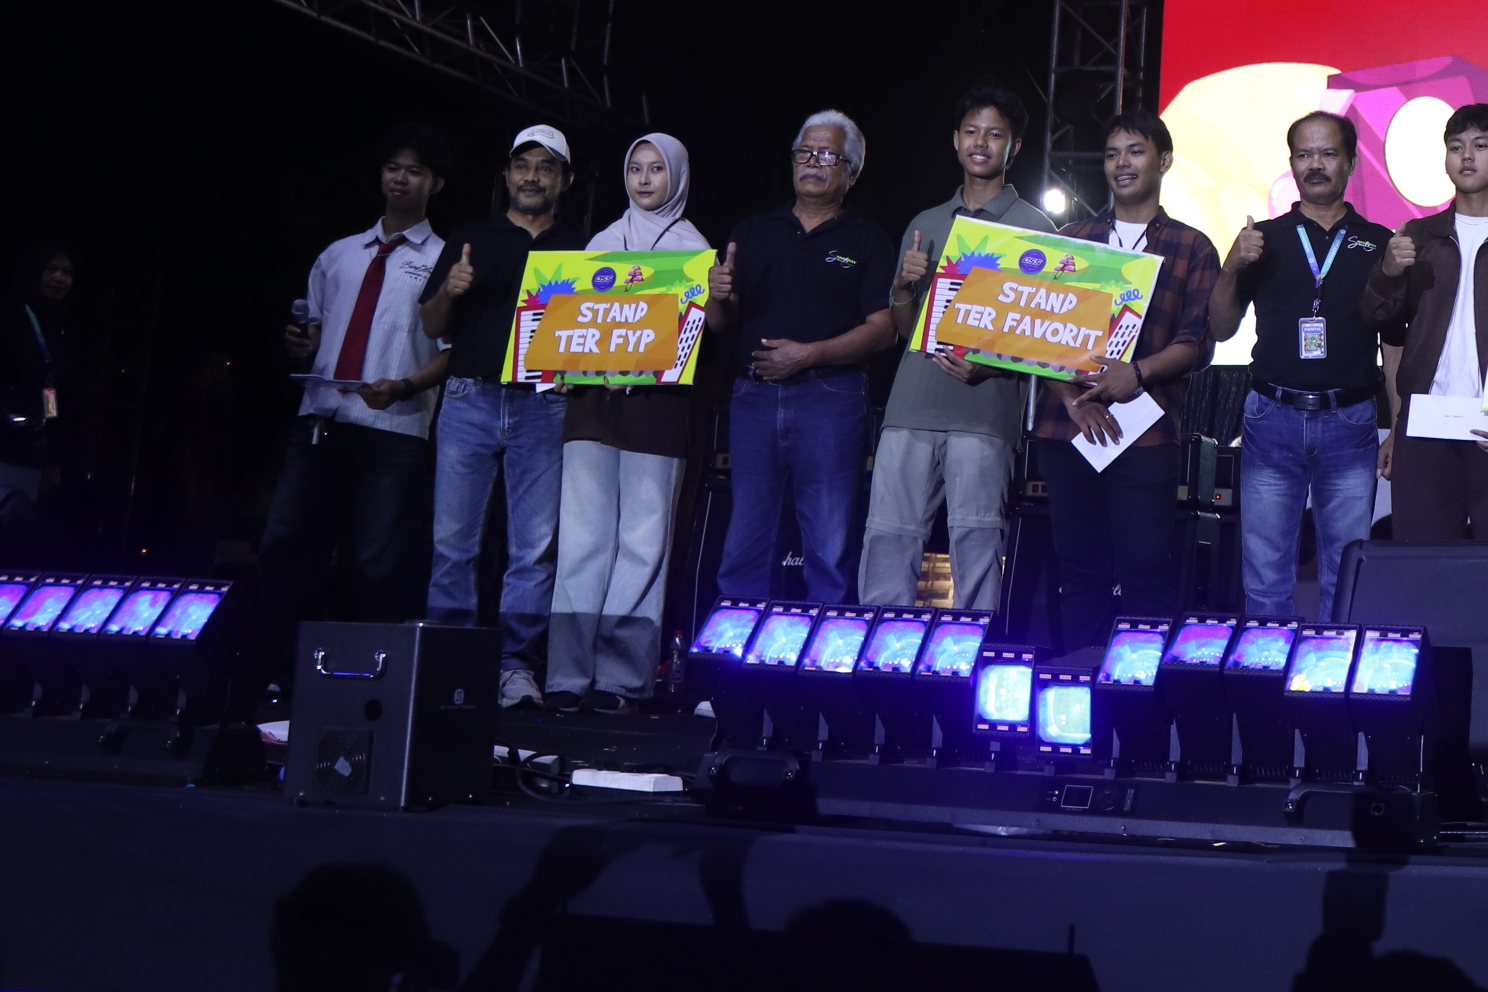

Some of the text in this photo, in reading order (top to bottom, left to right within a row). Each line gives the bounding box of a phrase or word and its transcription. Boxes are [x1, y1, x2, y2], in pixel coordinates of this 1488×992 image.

[575, 300, 649, 324] STAND
[997, 281, 1078, 315] STAND
[554, 327, 656, 354] TER FYP
[954, 302, 1104, 351] TER FAVORIT
